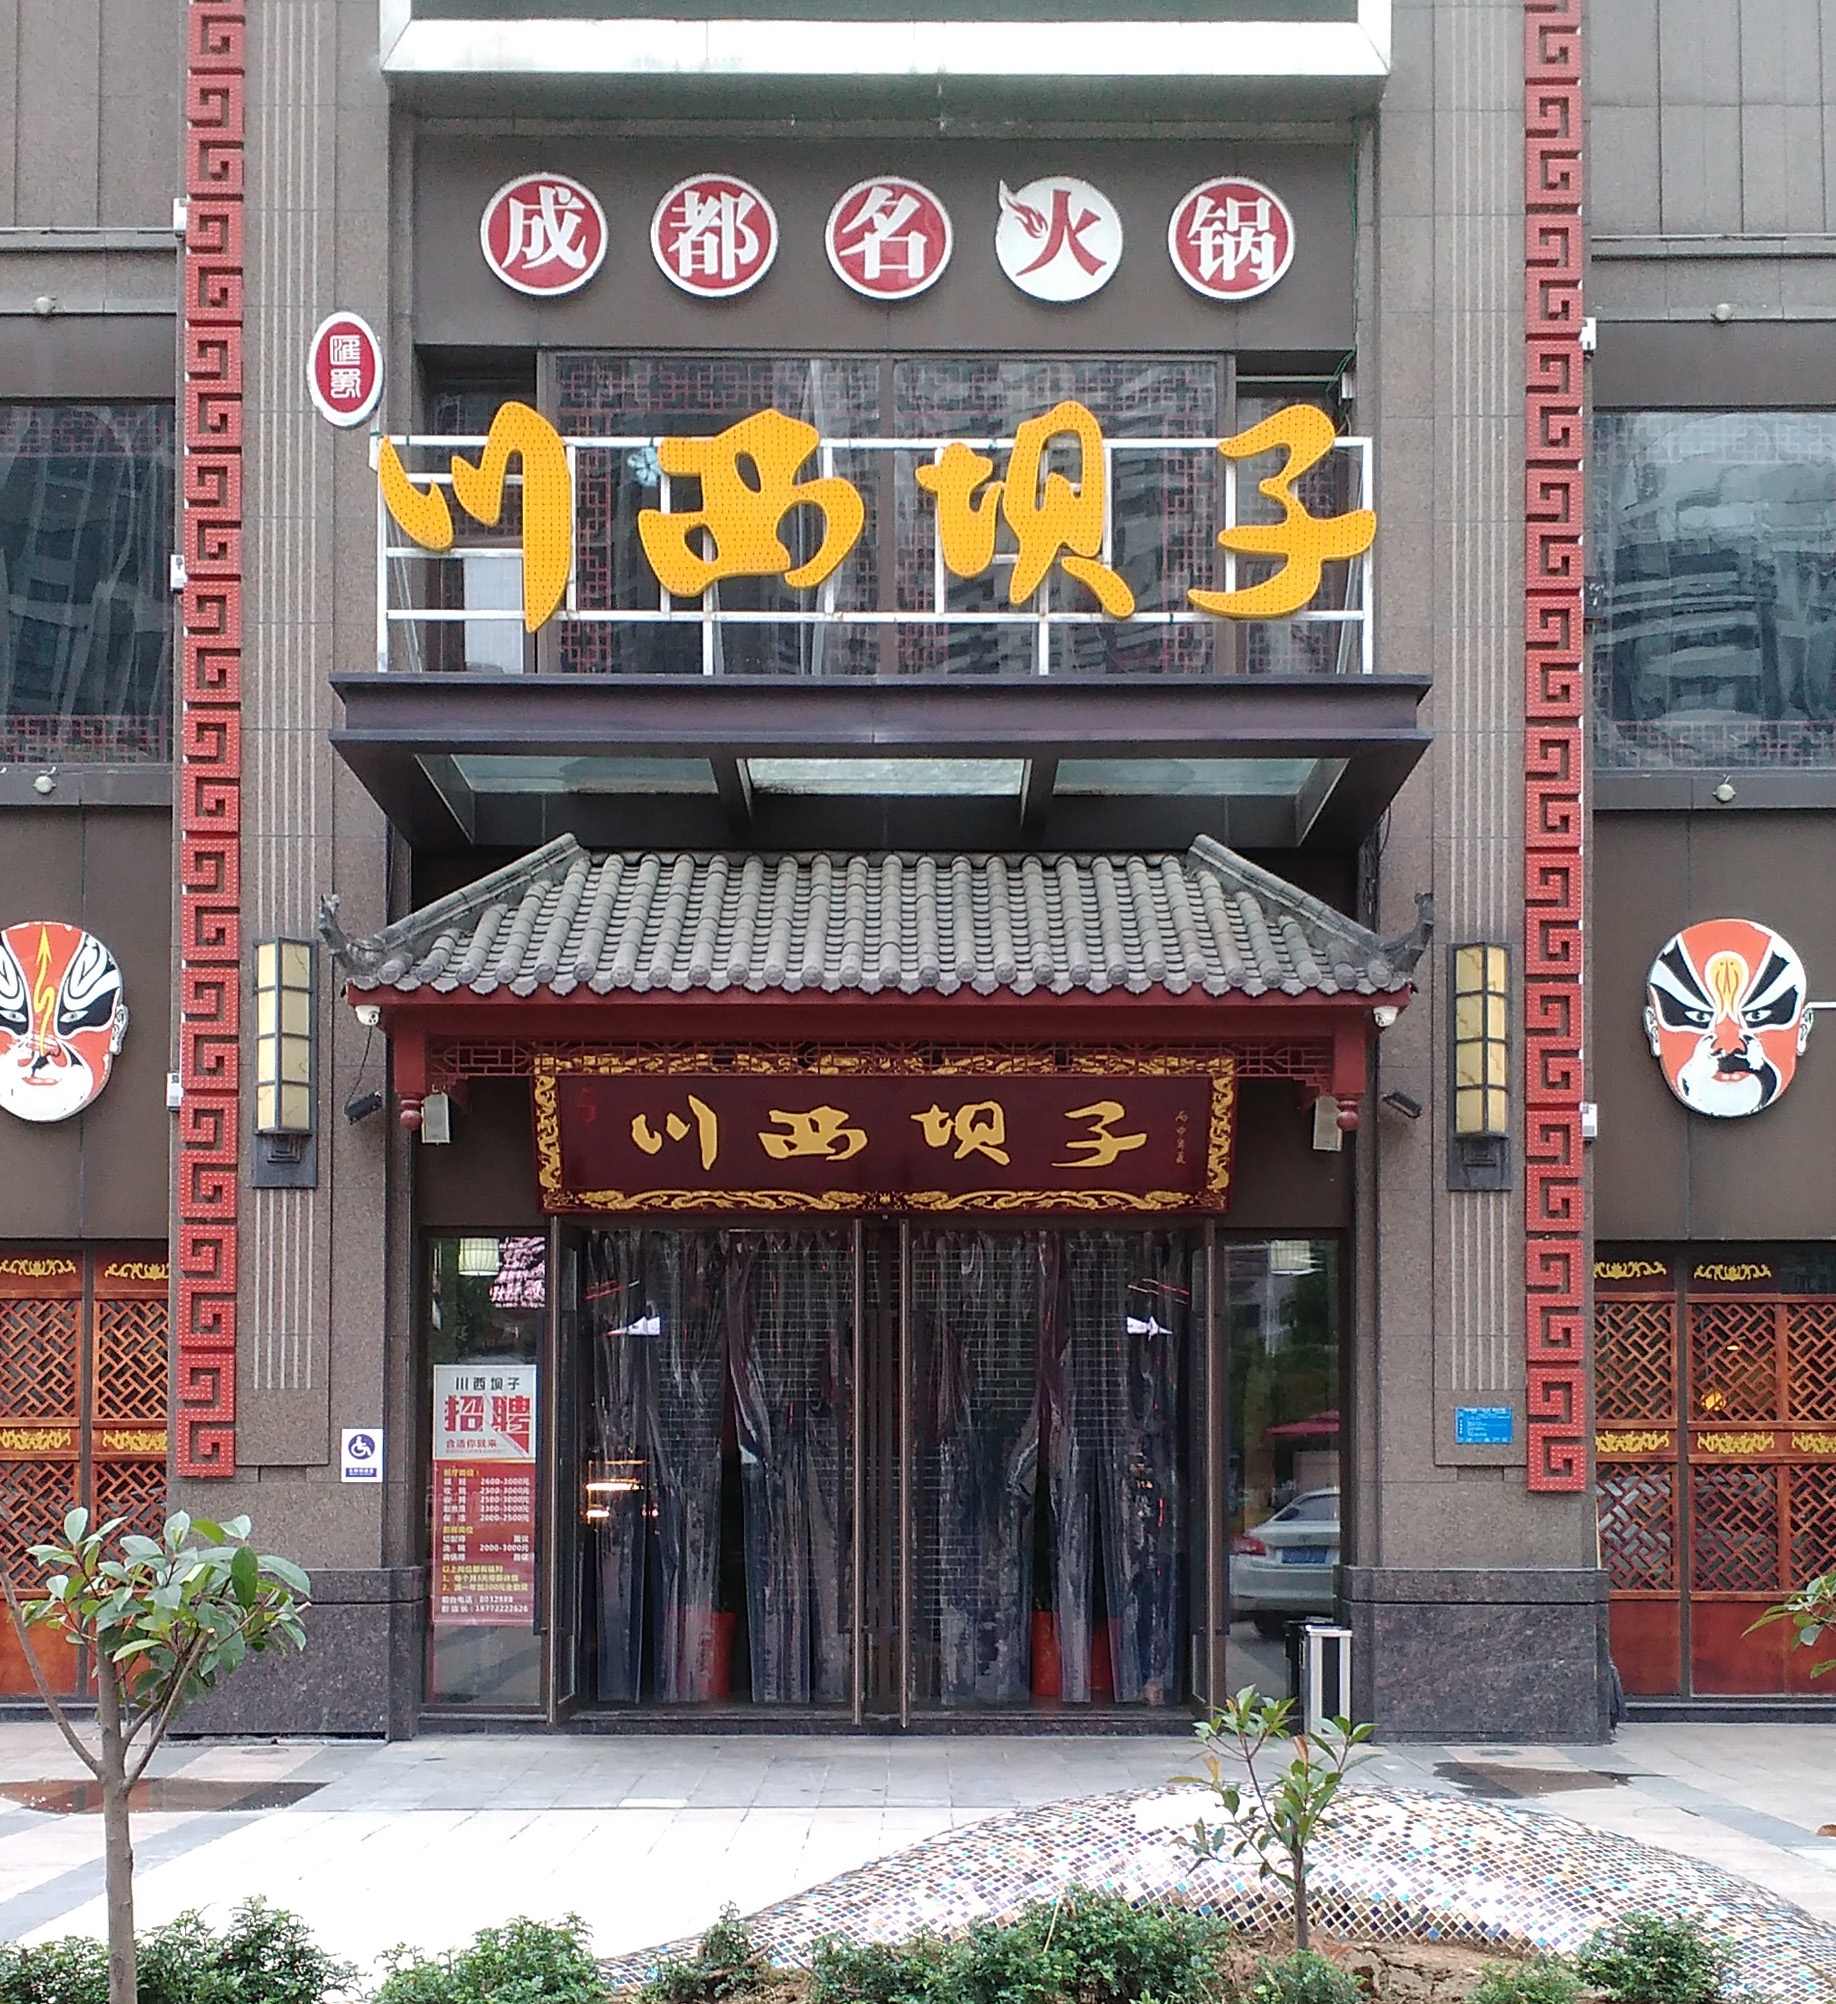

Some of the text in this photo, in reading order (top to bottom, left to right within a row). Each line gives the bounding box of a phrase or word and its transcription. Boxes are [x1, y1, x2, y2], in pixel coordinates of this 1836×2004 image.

[500, 184, 1277, 283] 成都名火锅
[377, 401, 1378, 633] 川西坝子
[630, 1094, 1148, 1171] 川西坝子
[444, 1395, 530, 1432] 招聘
[455, 1377, 520, 1391] 川西坝子
